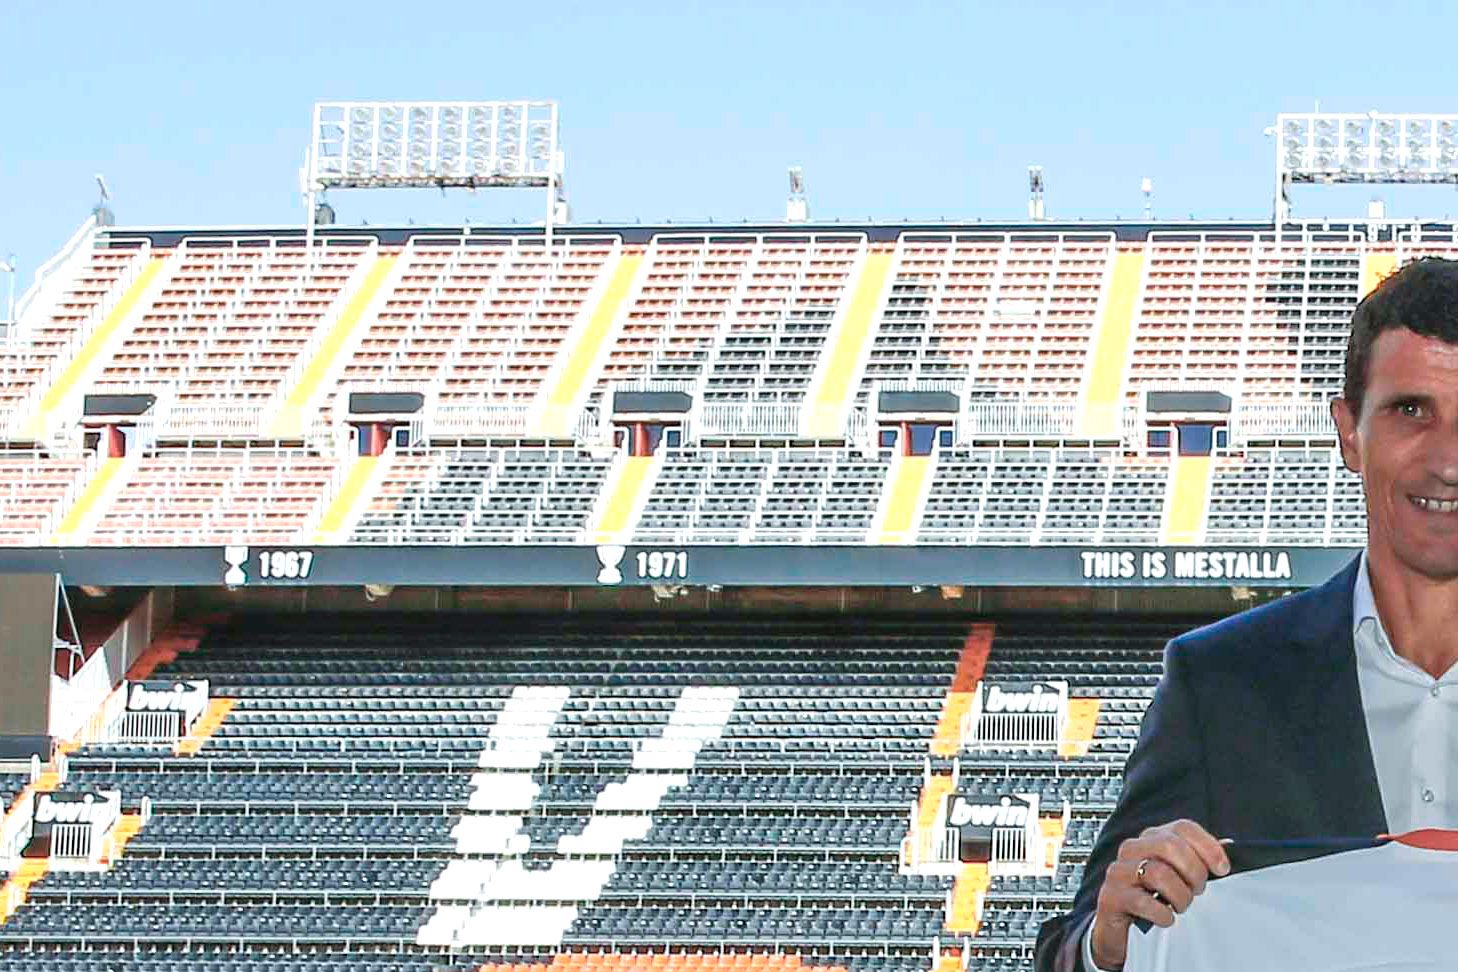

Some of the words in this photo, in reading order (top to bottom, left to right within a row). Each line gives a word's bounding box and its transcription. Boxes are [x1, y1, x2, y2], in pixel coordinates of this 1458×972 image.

[259, 551, 313, 578] 1967
[636, 551, 688, 577] 1971
[1081, 551, 1135, 578] THIS
[1142, 552, 1166, 578] IS
[1173, 552, 1291, 579] MESTALLA
[986, 685, 1058, 712] bwin
[950, 796, 1029, 826] bwin
